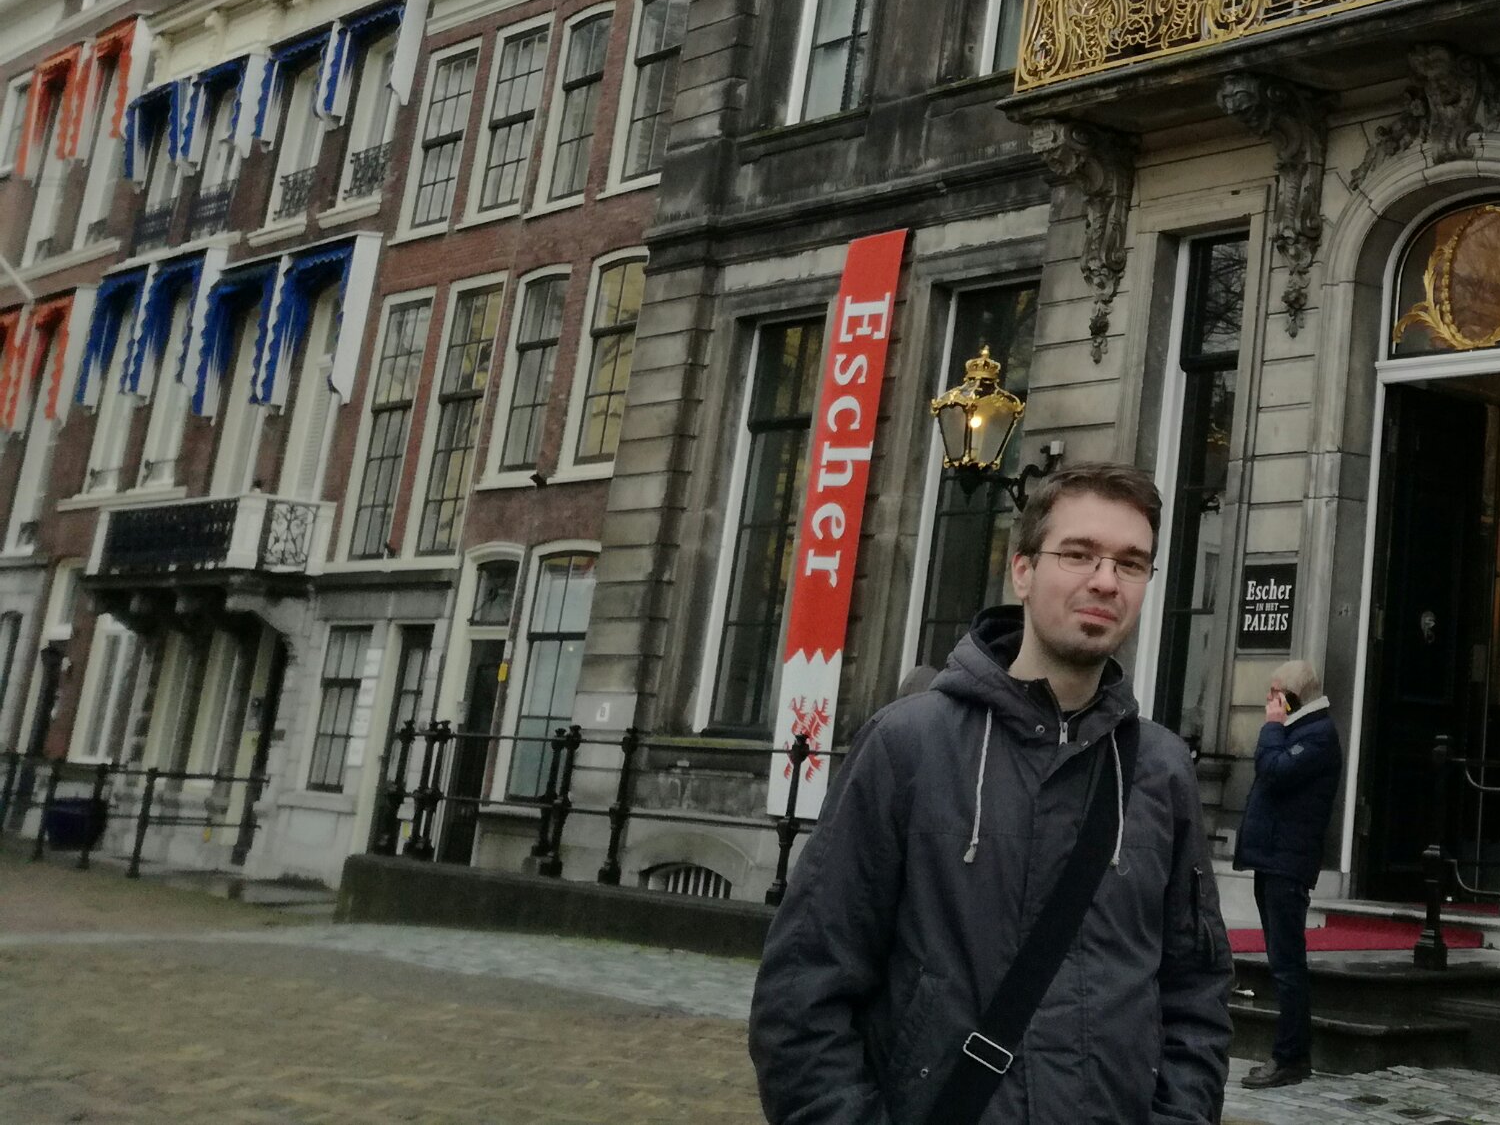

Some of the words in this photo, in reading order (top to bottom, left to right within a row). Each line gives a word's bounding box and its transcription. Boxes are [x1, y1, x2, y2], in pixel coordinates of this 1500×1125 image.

[805, 292, 891, 588] Escher
[1245, 578, 1292, 600] Escher
[1255, 602, 1264, 611] IN
[1265, 602, 1279, 611] HET
[1243, 613, 1289, 631] PALEIS
